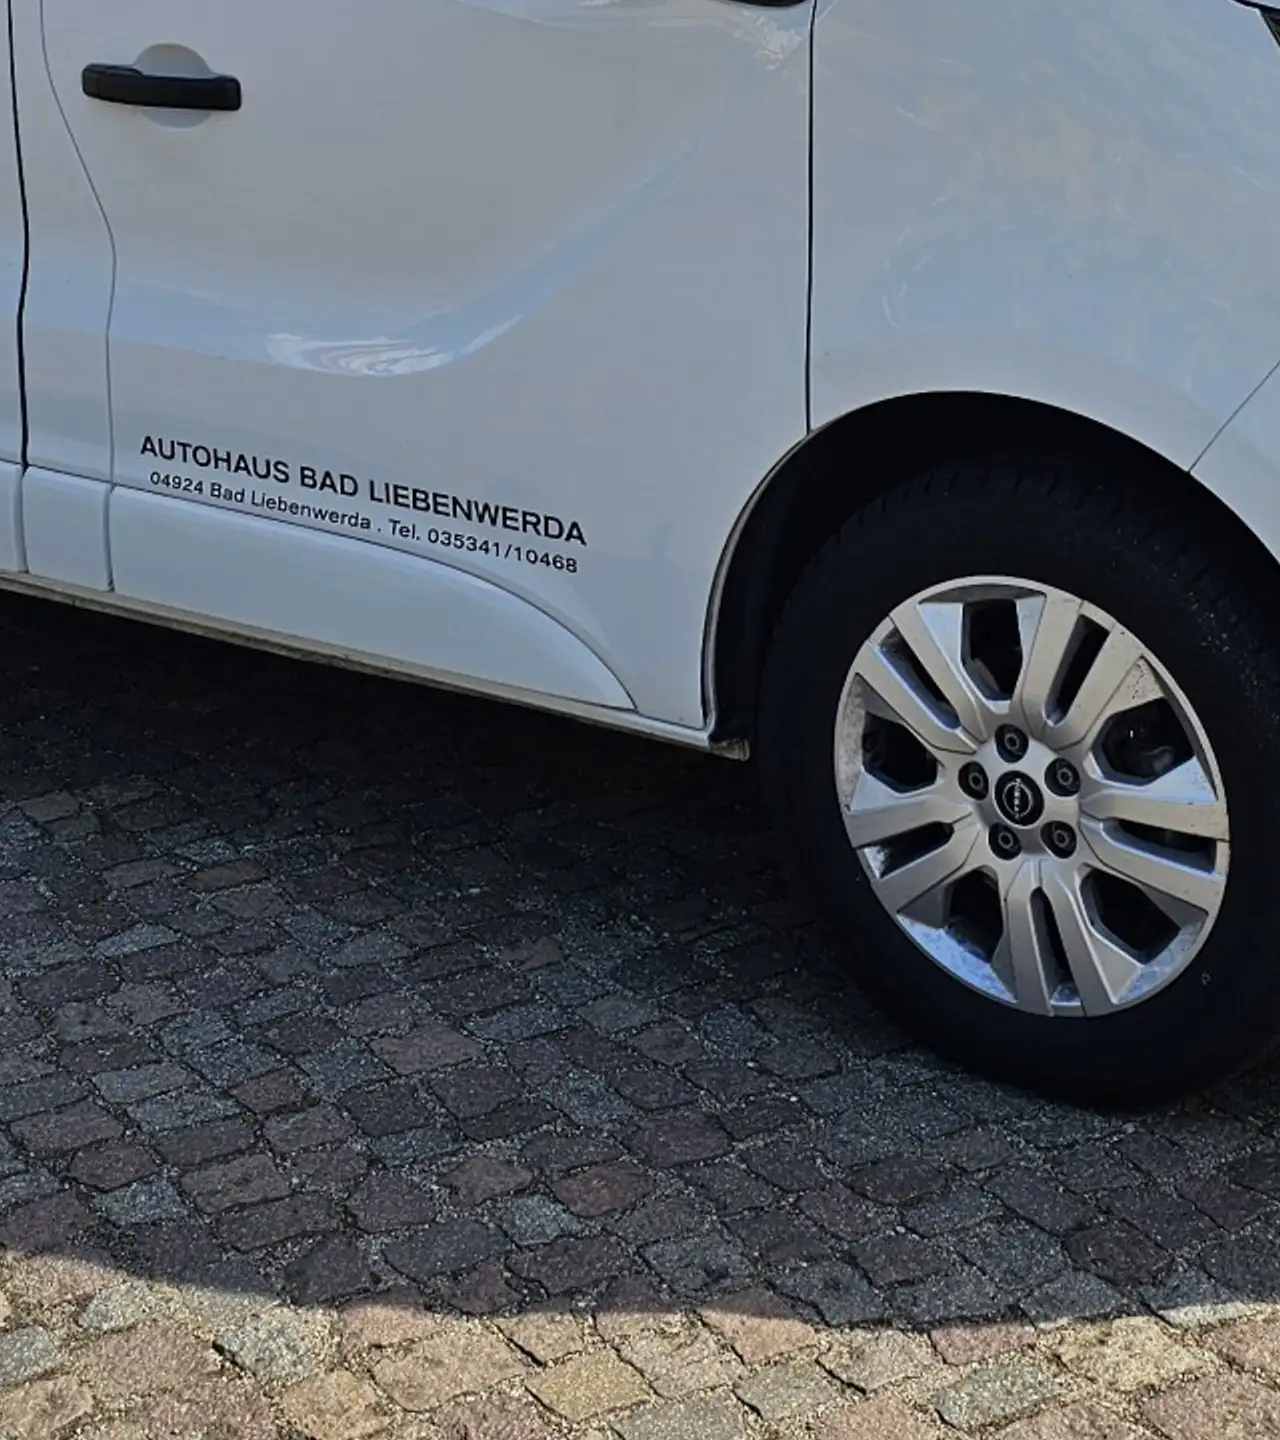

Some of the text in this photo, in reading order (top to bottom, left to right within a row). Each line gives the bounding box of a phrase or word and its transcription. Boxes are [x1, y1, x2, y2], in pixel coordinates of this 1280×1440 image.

[140, 435, 588, 547] AUTOHAUS BAD LIEBENWERDA
[149, 470, 204, 496] 04924
[209, 481, 246, 504] Bad
[250, 489, 372, 530] Liebenwerda
[388, 517, 421, 541] Tel.
[427, 527, 578, 574] 035341/10468
